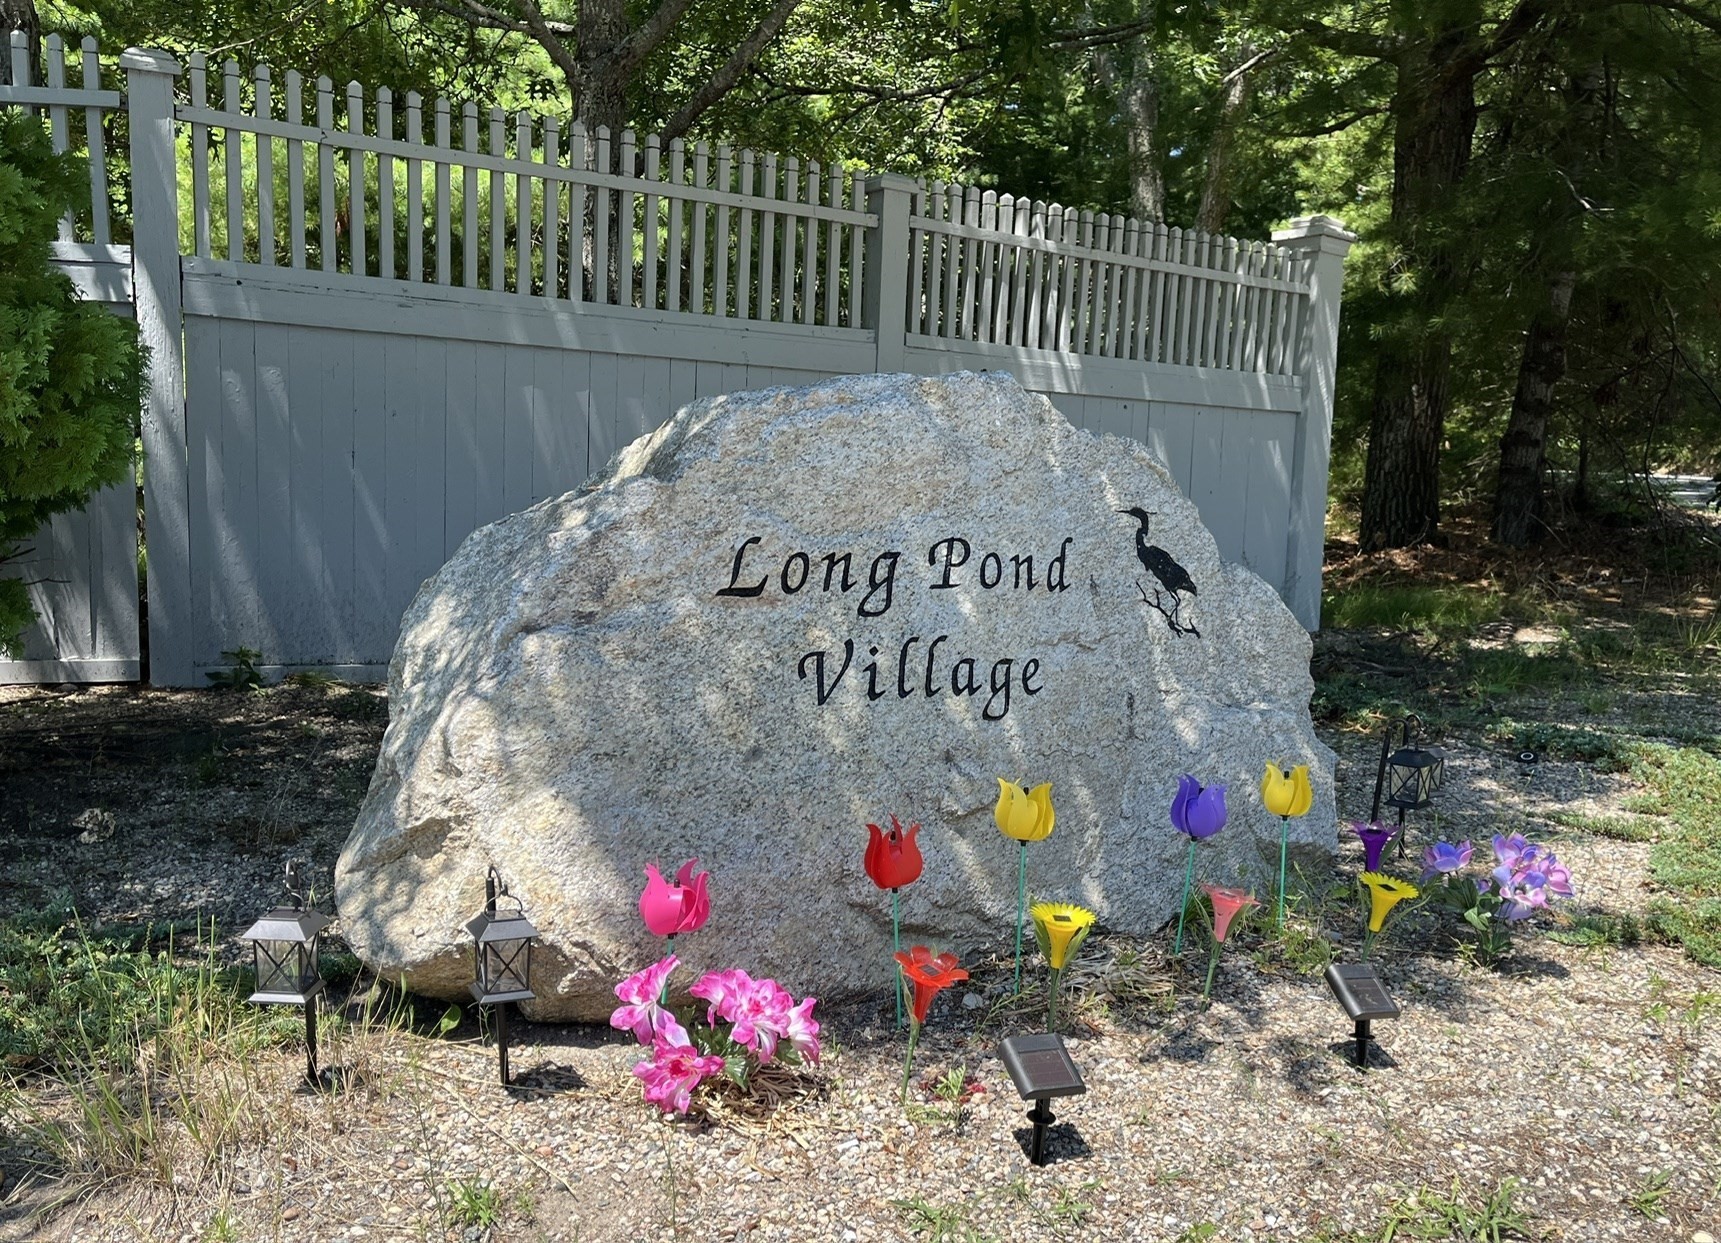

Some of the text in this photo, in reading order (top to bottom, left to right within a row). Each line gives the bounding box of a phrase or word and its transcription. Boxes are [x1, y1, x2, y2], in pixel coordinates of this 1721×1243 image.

[716, 536, 1073, 617] Long Pond
[798, 635, 1043, 721] Village
